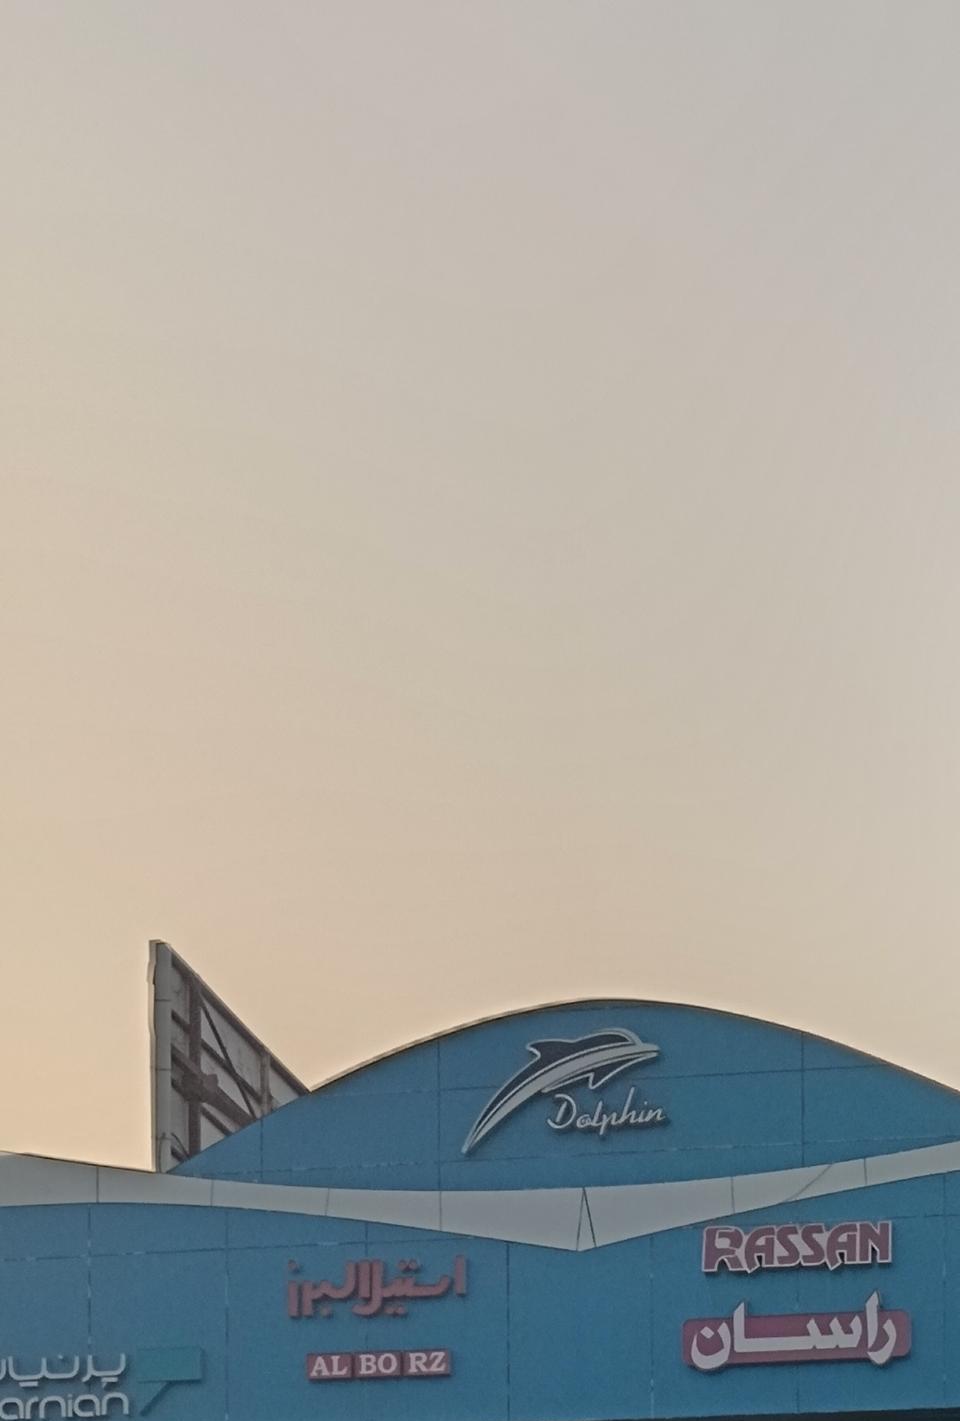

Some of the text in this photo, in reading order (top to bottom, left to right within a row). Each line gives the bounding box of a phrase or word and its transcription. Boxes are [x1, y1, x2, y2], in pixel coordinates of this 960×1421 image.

[547, 1086, 667, 1135] Dolphin
[702, 1220, 892, 1273] RASSAN
[691, 1290, 897, 1369] راسان
[0, 1392, 130, 1421] arnian
